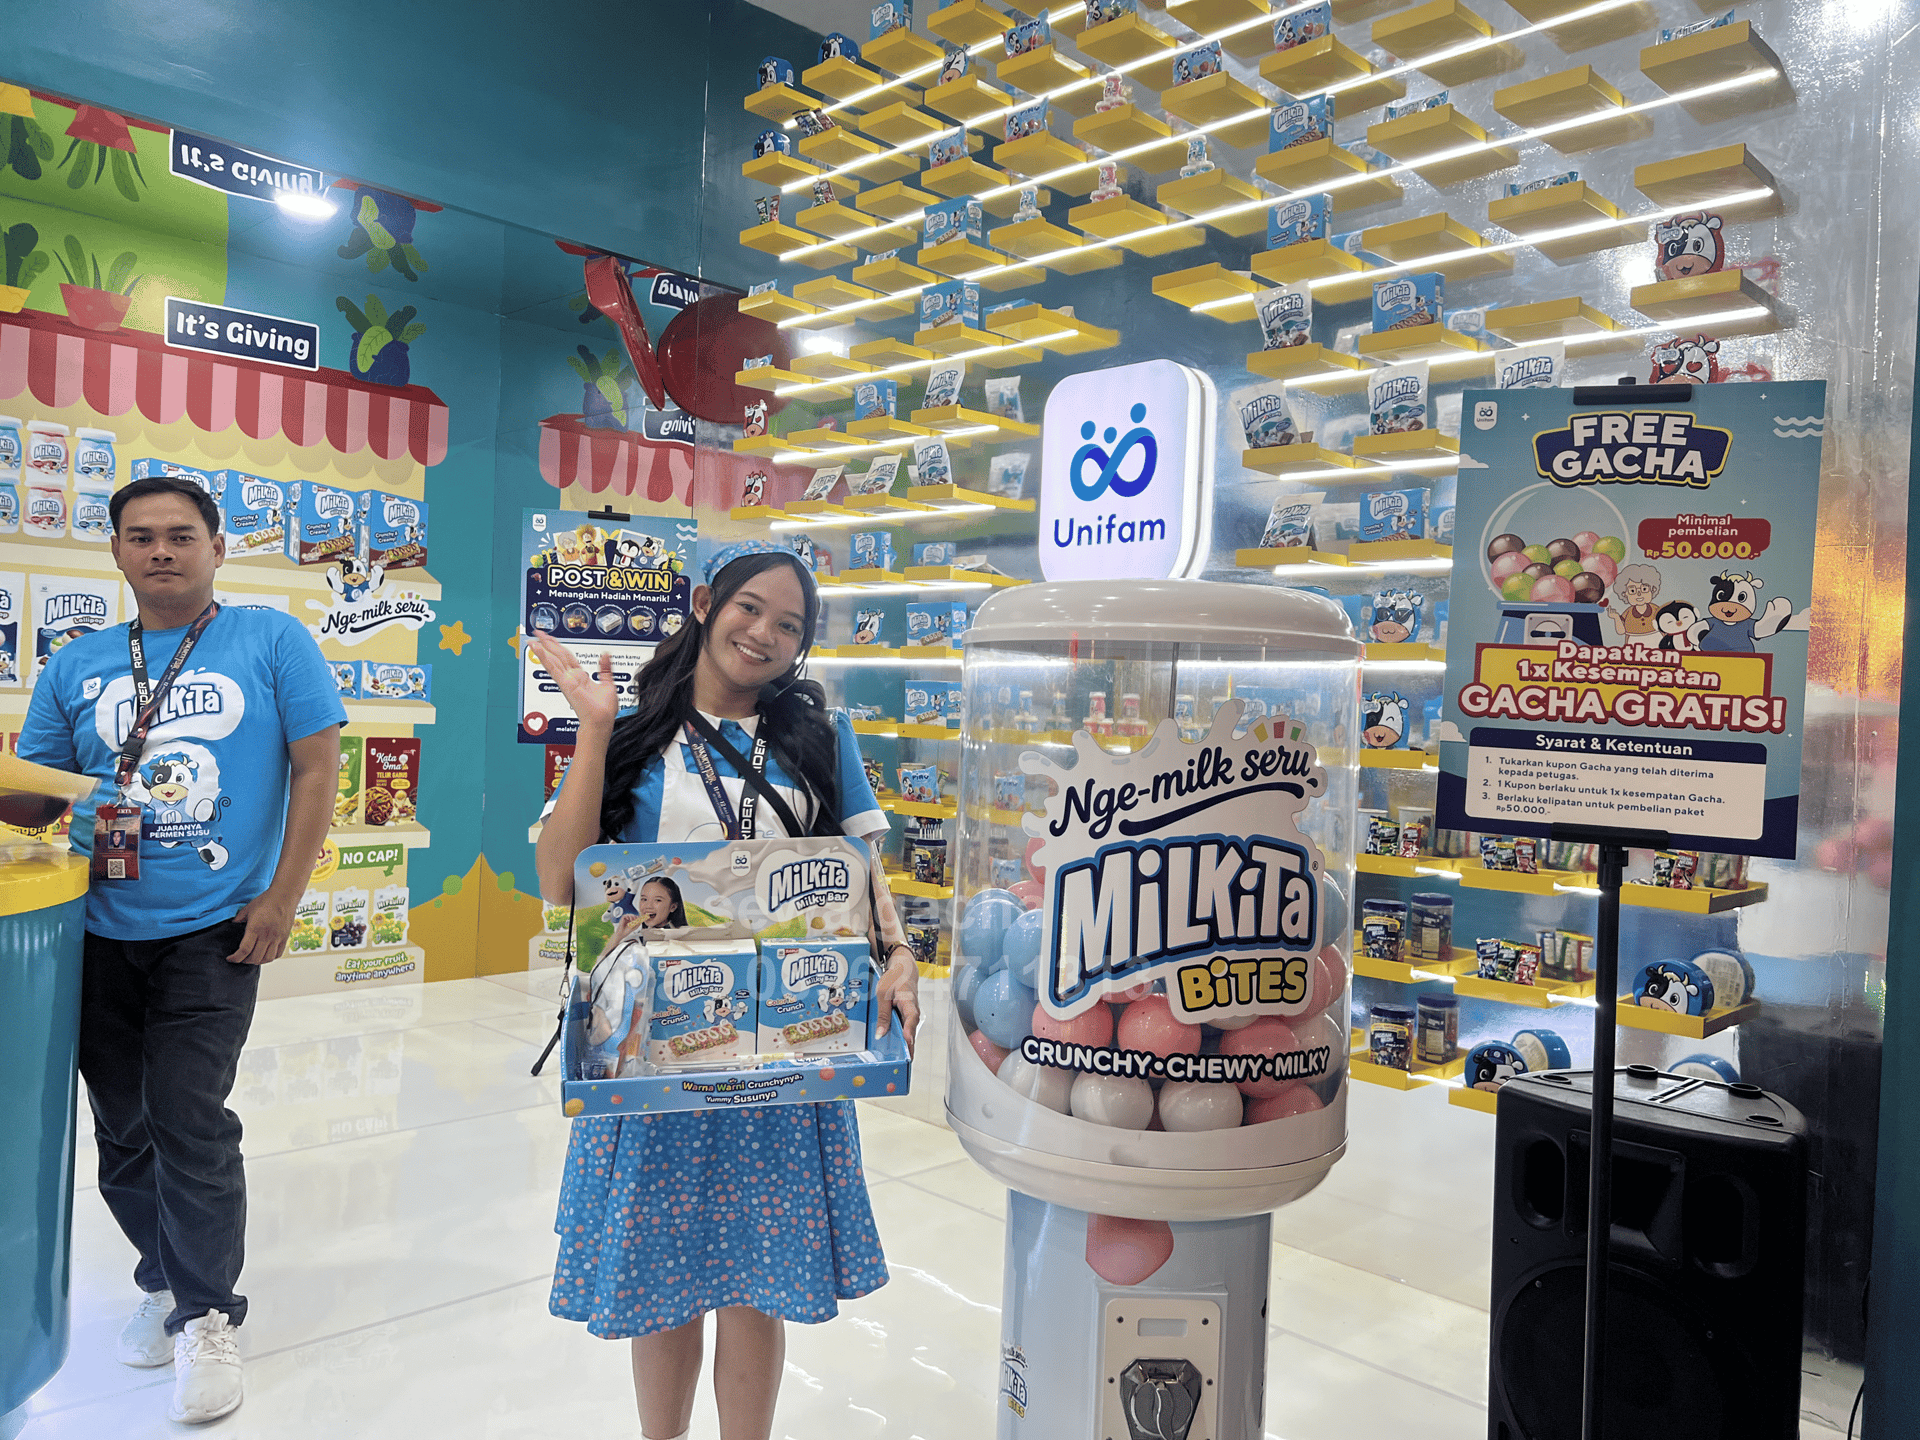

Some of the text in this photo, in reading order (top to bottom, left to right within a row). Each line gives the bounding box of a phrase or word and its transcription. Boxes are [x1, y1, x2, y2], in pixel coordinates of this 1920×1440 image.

[176, 312, 310, 361] It's Giving
[1573, 415, 1690, 446] FREE
[1552, 446, 1705, 479] GACHA
[1054, 513, 1166, 548] Unifam
[1678, 515, 1731, 527] Minimal
[1668, 526, 1738, 538] pembelian
[1646, 540, 1761, 560] Rp50.000,-
[549, 589, 670, 603] Menangkan Hadiah Menarik!
[73, 617, 105, 625] Lollipop
[321, 600, 425, 634] Nge-milk seru
[131, 638, 143, 669] RIDER
[1559, 641, 1680, 665] Dapatkan
[1519, 660, 1720, 689] 1x Kesempatan
[116, 684, 222, 747] MLKiTa
[1461, 685, 1785, 730] GACHA GRATIS!
[753, 738, 767, 773] IDER
[1536, 735, 1693, 756] Syarat & Ketentuan
[376, 753, 397, 763] Kata
[1485, 756, 1714, 779] 1. Tukarkan kupon Gacha yang telah diterima
[1498, 768, 1579, 781] kepada petugas.
[1049, 746, 1311, 840] Nge-milk seru
[1483, 779, 1491, 787] 2.
[1504, 780, 1536, 790] Kupon
[1539, 783, 1575, 793] berlaku
[1578, 786, 1608, 795] untuk
[1610, 788, 1620, 796] 1x
[1623, 789, 1685, 801] kesempatan
[1689, 793, 1725, 804] Gacha.
[1482, 792, 1704, 817] 3. Berlaku kelipatan untuk pembelian paket
[156, 824, 202, 832] JUARANYA
[187, 829, 210, 837] SUSU
[343, 849, 399, 865] NO CAP!
[795, 891, 849, 911] Milky Bar
[336, 963, 415, 982] anytime anywhere
[346, 960, 362, 969] Eat
[363, 959, 382, 970] your
[689, 985, 723, 998] Milky Bar
[766, 995, 797, 1007] Colorful
[777, 1002, 804, 1013] Crunch
[661, 1013, 689, 1026] Crunch
[1022, 1039, 1330, 1079] CRUNCHY CHEWY MILKY
[683, 1081, 714, 1092] Warna
[717, 1081, 745, 1092] Warni
[706, 1091, 777, 1104] Yummy Susunya
